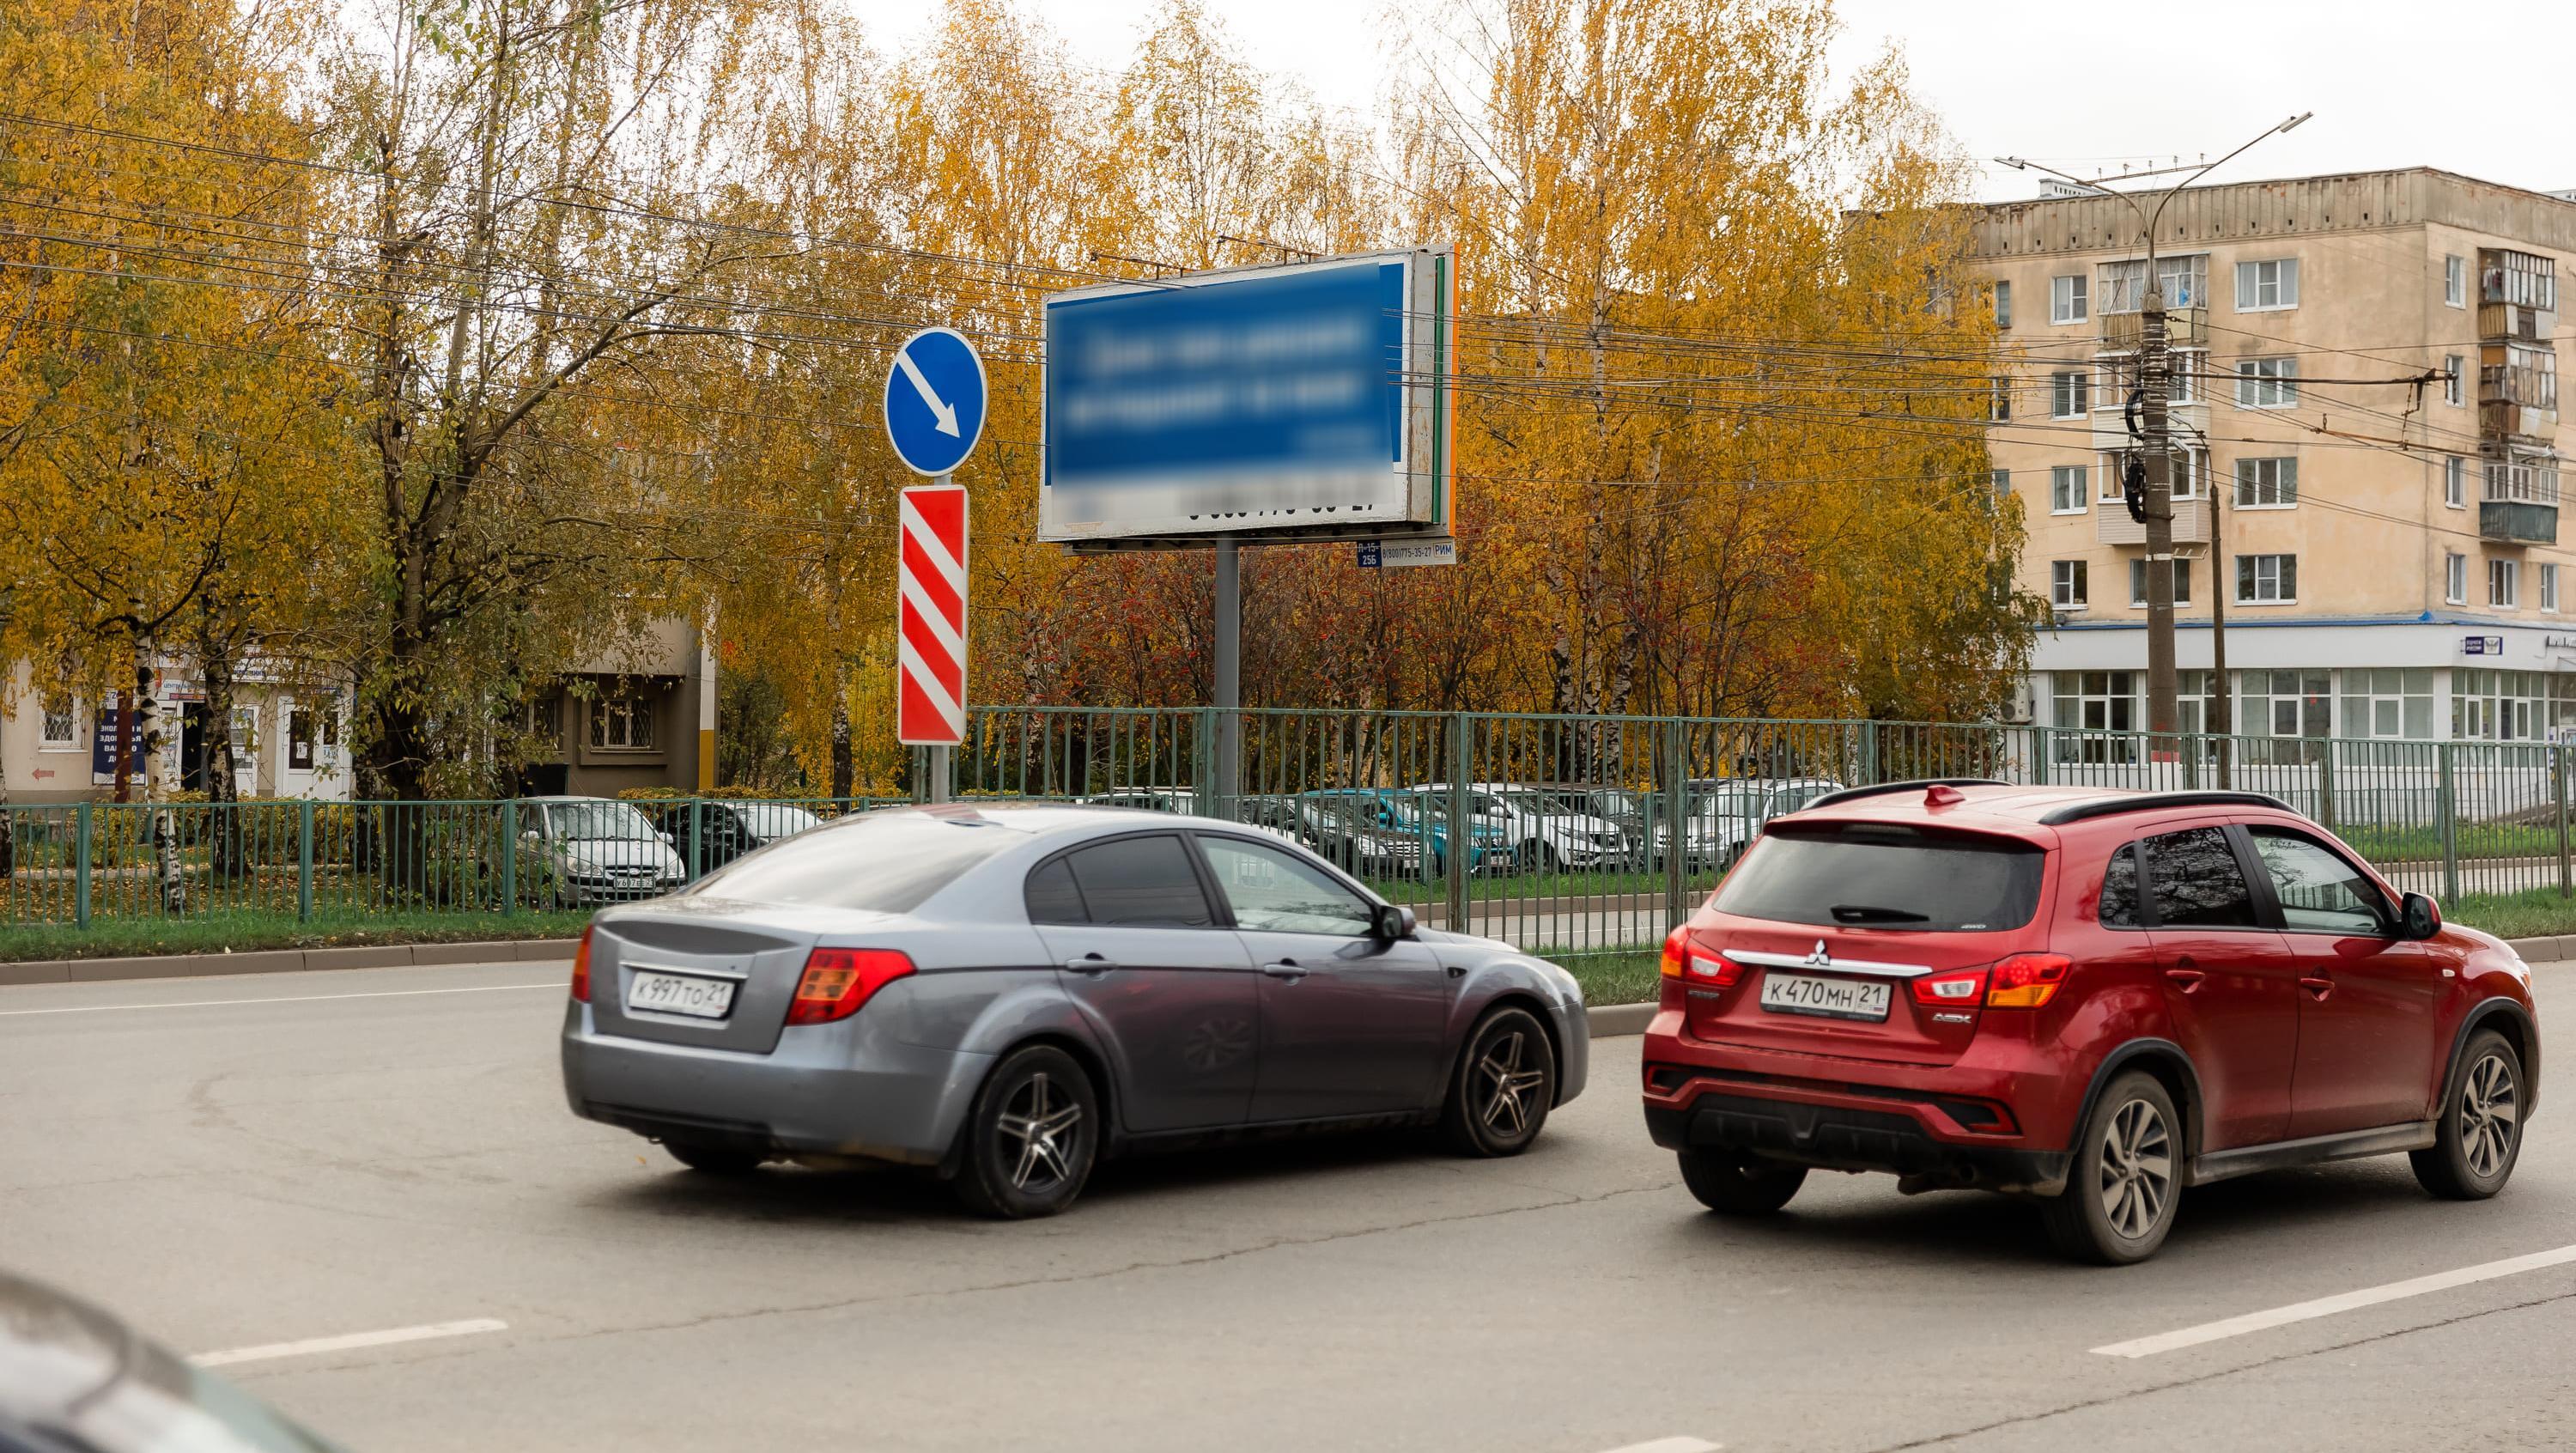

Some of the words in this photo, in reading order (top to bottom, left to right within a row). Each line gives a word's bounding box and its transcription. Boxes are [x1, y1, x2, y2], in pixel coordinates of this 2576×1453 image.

[1382, 546, 1432, 559] 8(800)775-35-27
[1435, 544, 1452, 556] РИМ
[1771, 980, 1853, 1007] К470МН
[1859, 985, 1881, 1004] 21
[1933, 1013, 1972, 1024] ASX
